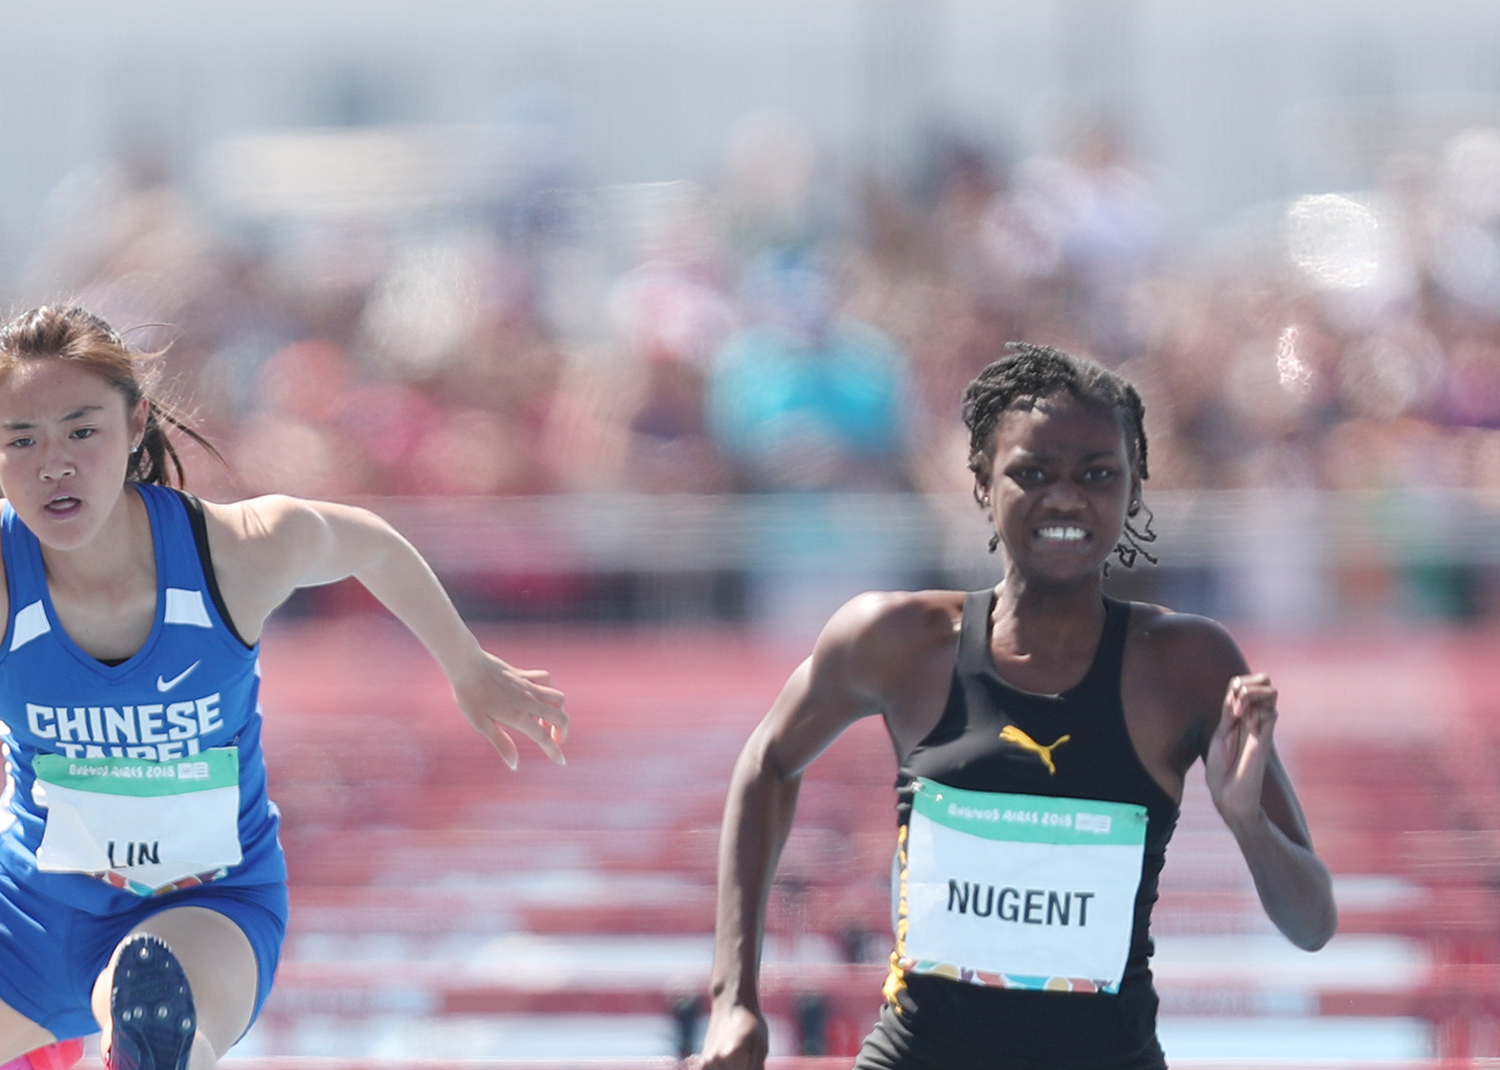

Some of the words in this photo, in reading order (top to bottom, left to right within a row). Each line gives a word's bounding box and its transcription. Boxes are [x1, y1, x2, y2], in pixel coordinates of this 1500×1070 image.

[26, 692, 223, 744] CHINESE
[145, 765, 175, 778] 2018
[108, 841, 161, 868] LIN
[947, 878, 1095, 927] NUGENT
